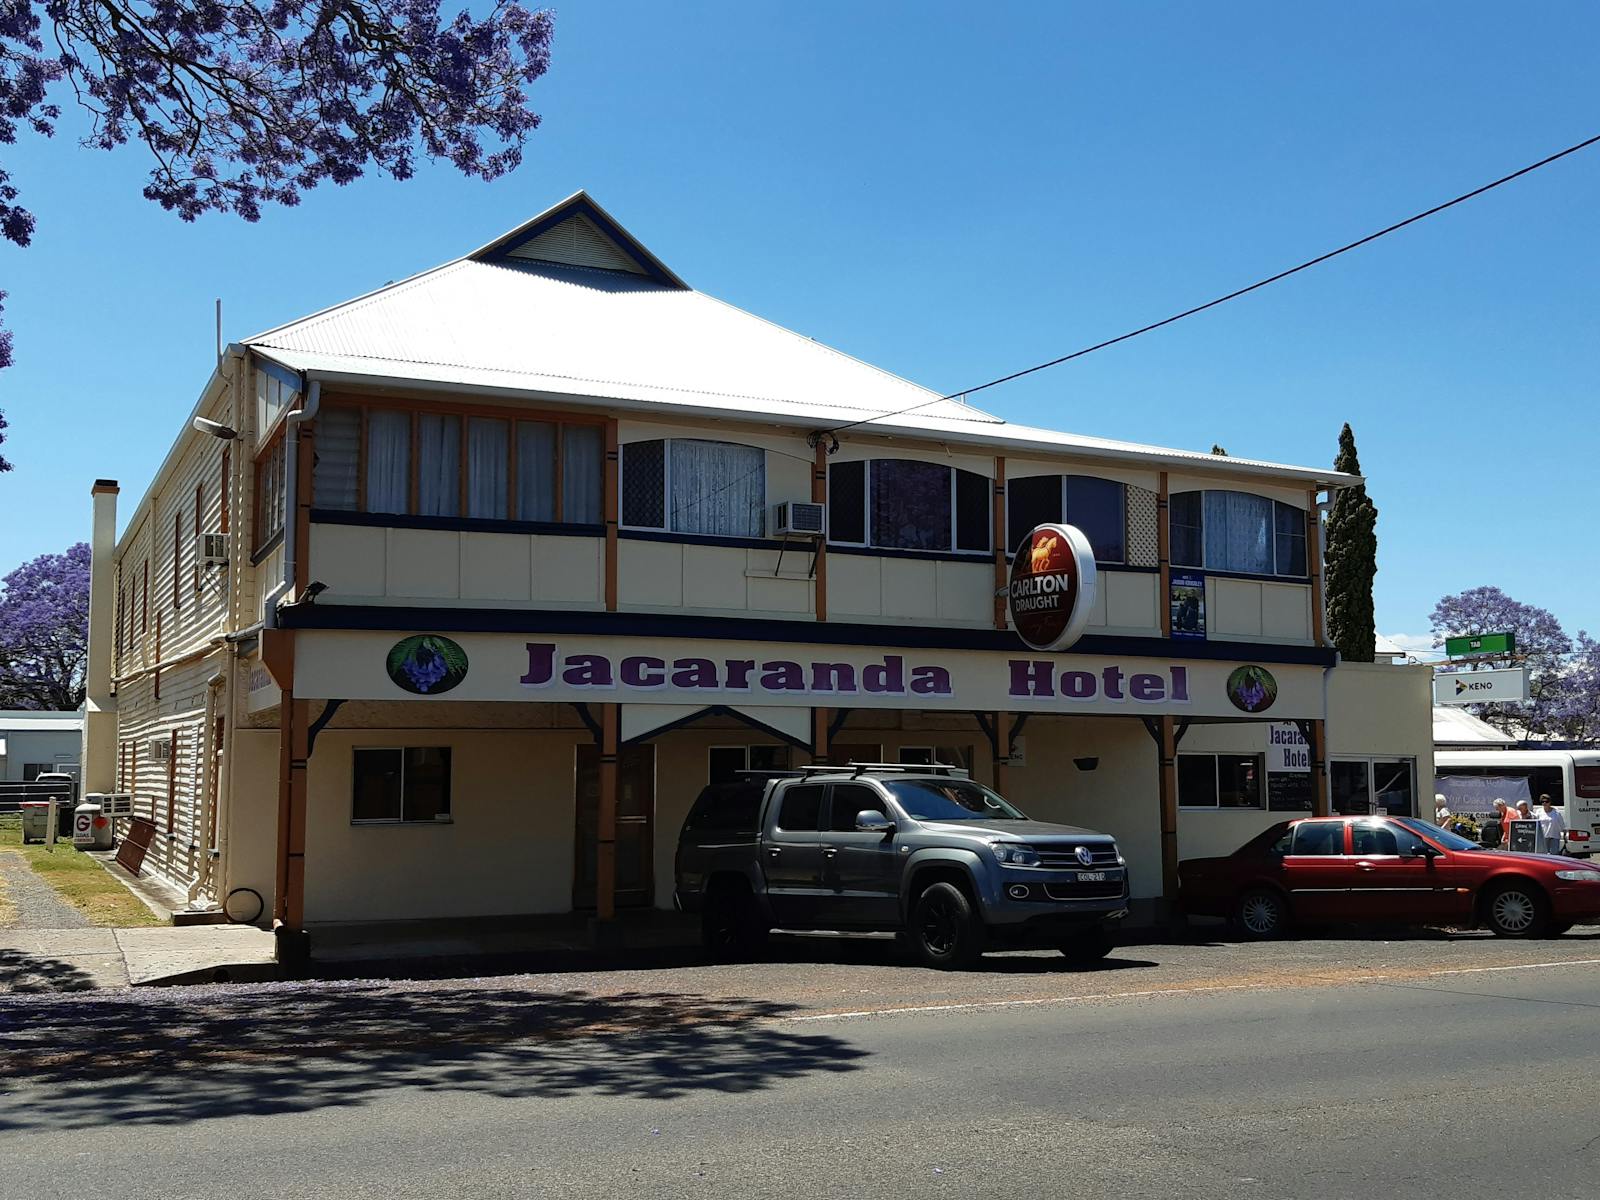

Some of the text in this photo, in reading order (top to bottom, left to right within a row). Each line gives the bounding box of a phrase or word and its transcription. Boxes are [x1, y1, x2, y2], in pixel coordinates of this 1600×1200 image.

[1011, 573, 1069, 598] CARLTON
[1015, 594, 1060, 611] DRAUGHT
[520, 642, 1190, 703] Jacaranda Hotel
[1468, 682, 1493, 690] KENO
[1269, 725, 1307, 745] Jacara
[1283, 748, 1311, 767] Hotel
